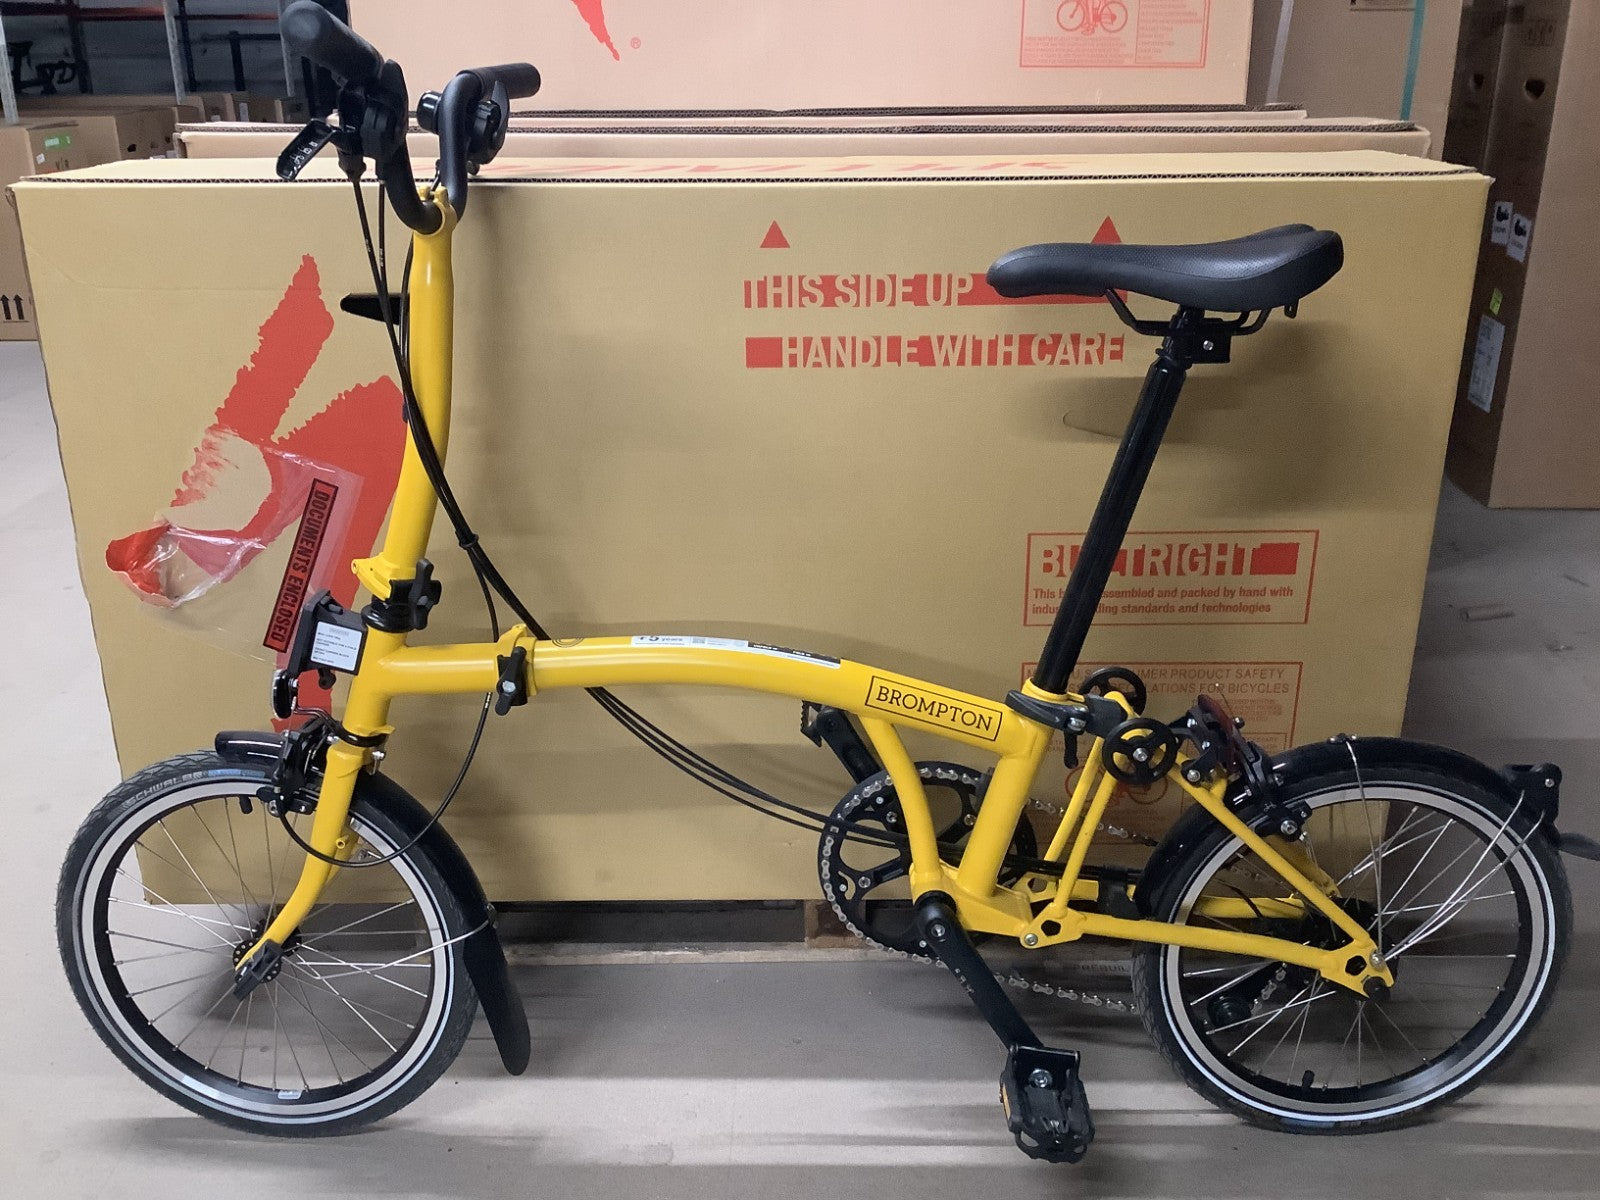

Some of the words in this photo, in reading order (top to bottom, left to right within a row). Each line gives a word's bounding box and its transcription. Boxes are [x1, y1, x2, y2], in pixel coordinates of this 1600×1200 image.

[743, 274, 824, 308] THIS
[834, 273, 915, 307] SIDE
[926, 272, 973, 307] UP
[781, 335, 920, 368] HANDLE
[930, 334, 1020, 367] WITH
[1031, 332, 1124, 366] CARE
[292, 490, 331, 574] DOCUMENTS
[270, 575, 304, 643] ENCLOSED
[1033, 588, 1056, 599] This
[1100, 587, 1154, 599] ssembled
[1157, 587, 1178, 598] and
[1181, 586, 1220, 601] packed
[1223, 586, 1236, 600] by
[1239, 586, 1267, 597] hand
[1269, 586, 1294, 597] with
[1121, 602, 1175, 614] standards
[1178, 602, 1198, 613] and
[1201, 601, 1271, 616] technologies
[1169, 668, 1231, 680] PRODUCT
[1234, 668, 1286, 680] SAFETY
[1199, 682, 1223, 694] FOR
[1227, 682, 1289, 694] BICYCLES
[875, 685, 994, 732] BROMPTON
